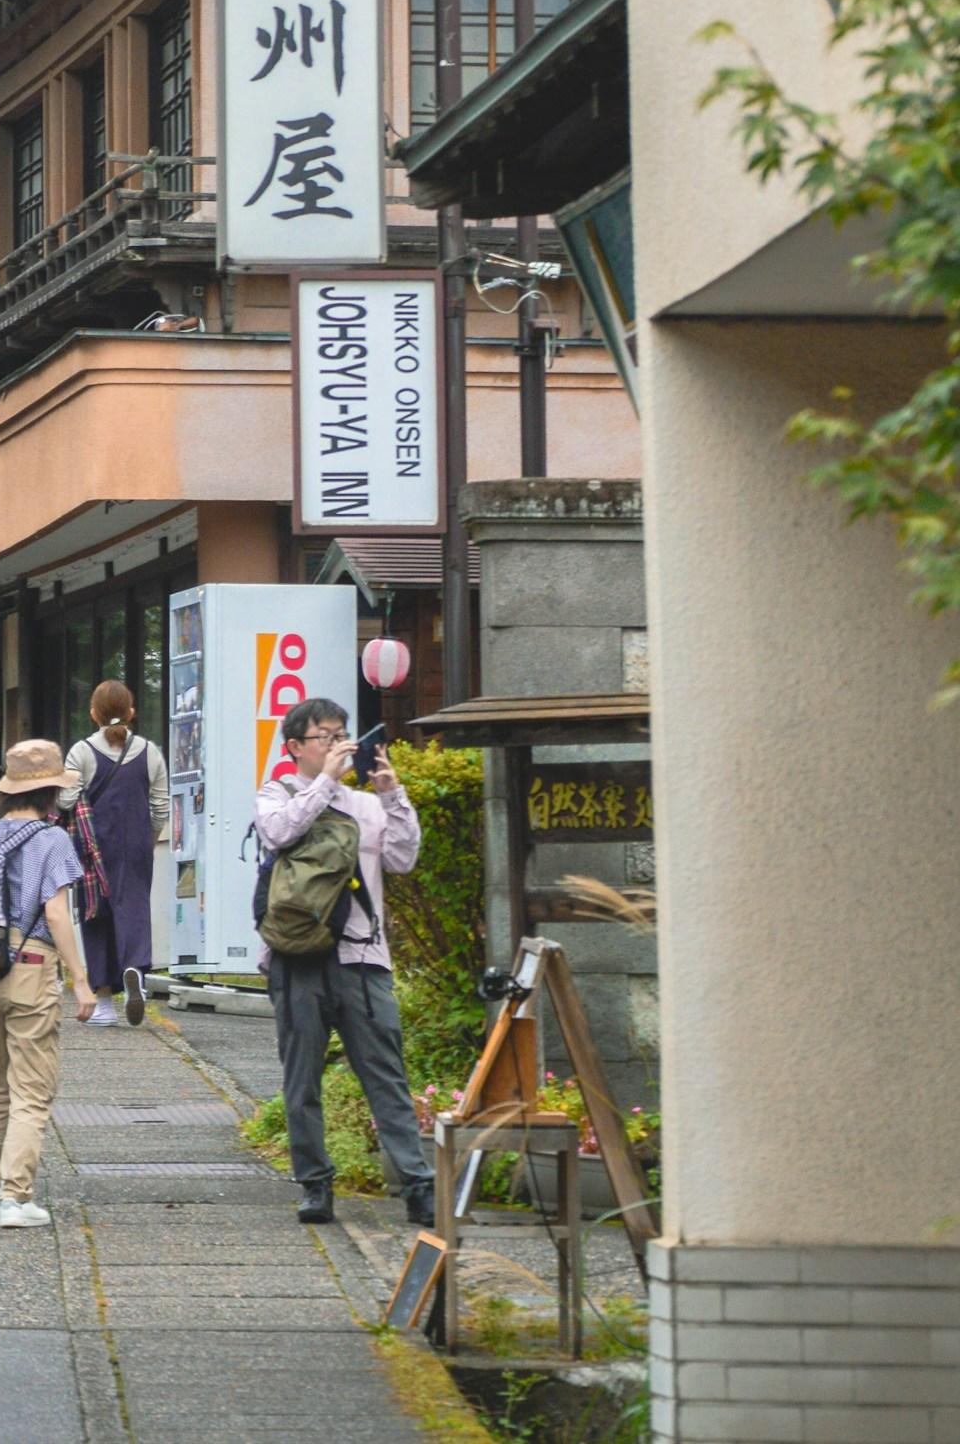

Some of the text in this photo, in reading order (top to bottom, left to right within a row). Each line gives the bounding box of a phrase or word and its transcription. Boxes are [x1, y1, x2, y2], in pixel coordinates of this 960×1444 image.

[317, 286, 370, 519] JOHSYU-YA INN
[394, 292, 421, 479] NIKKO ONSEN
